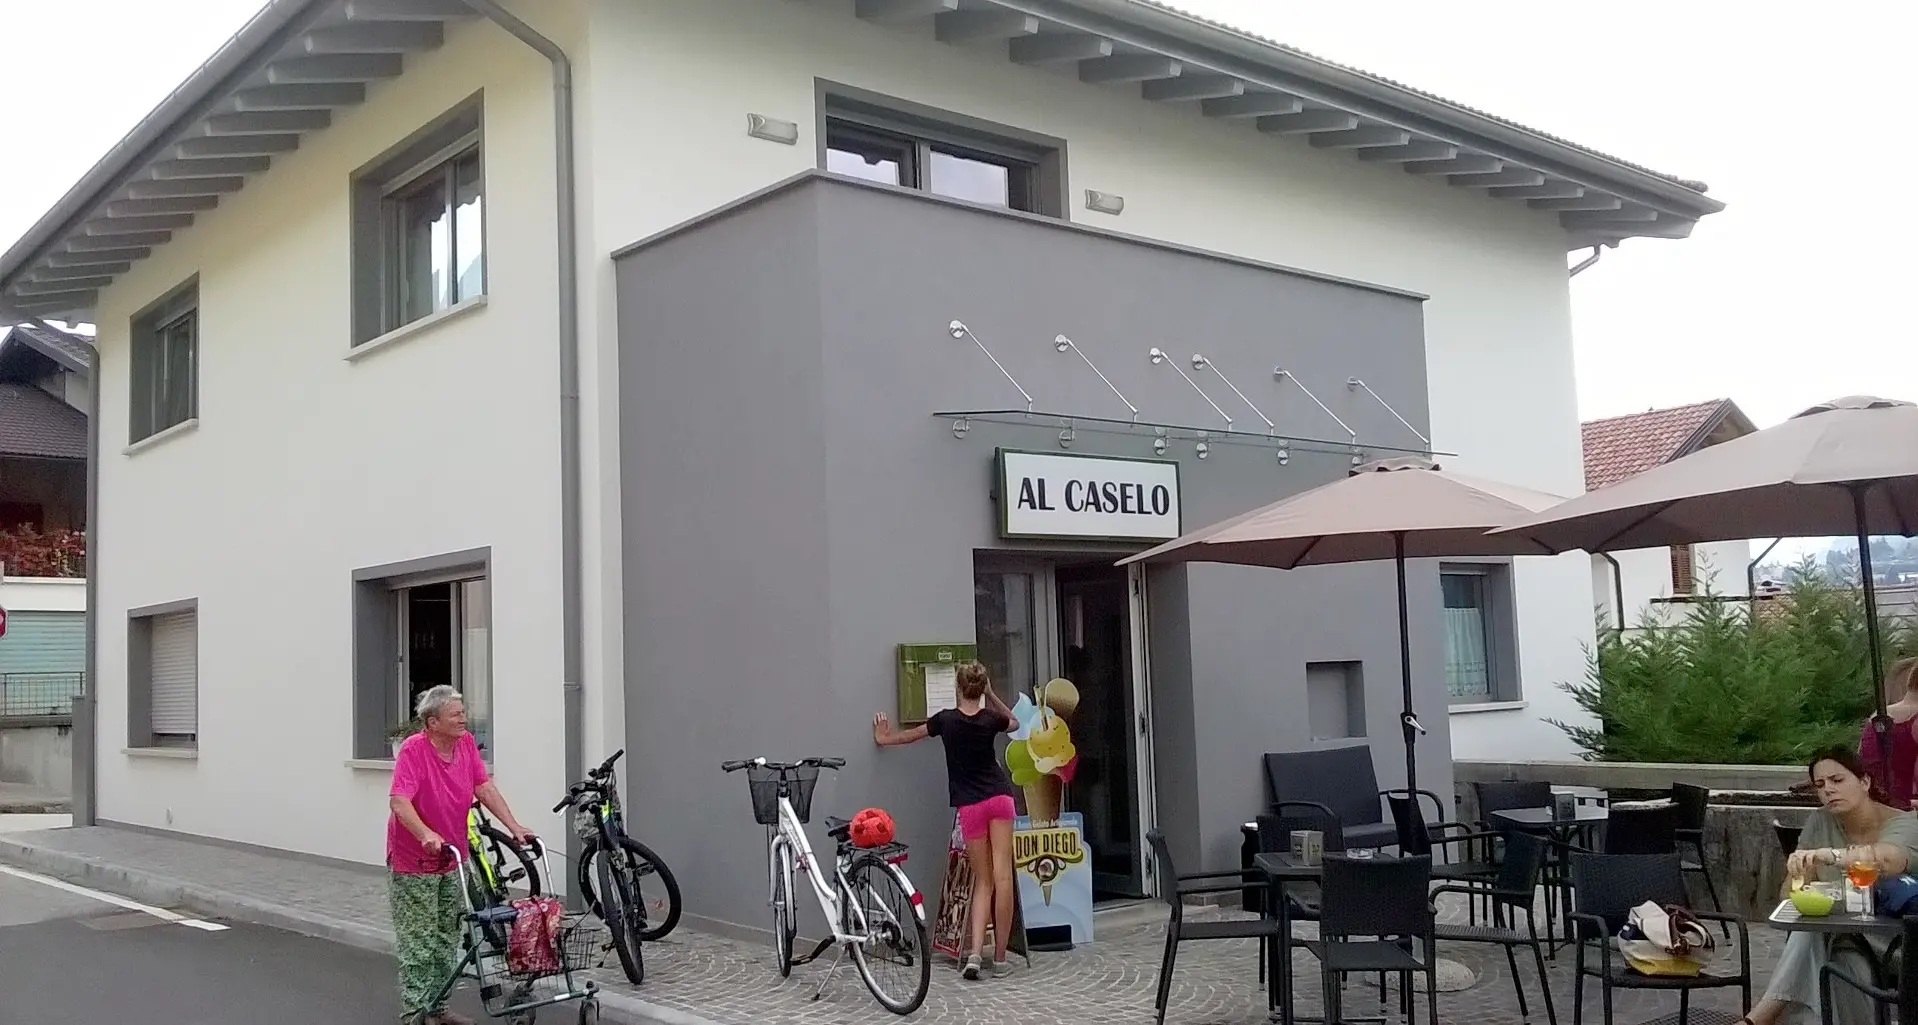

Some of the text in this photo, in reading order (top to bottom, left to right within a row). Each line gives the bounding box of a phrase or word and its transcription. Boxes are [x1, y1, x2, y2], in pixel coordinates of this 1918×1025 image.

[1018, 477, 1170, 516] AL CASELO
[1016, 832, 1076, 859] DON DIEGO
